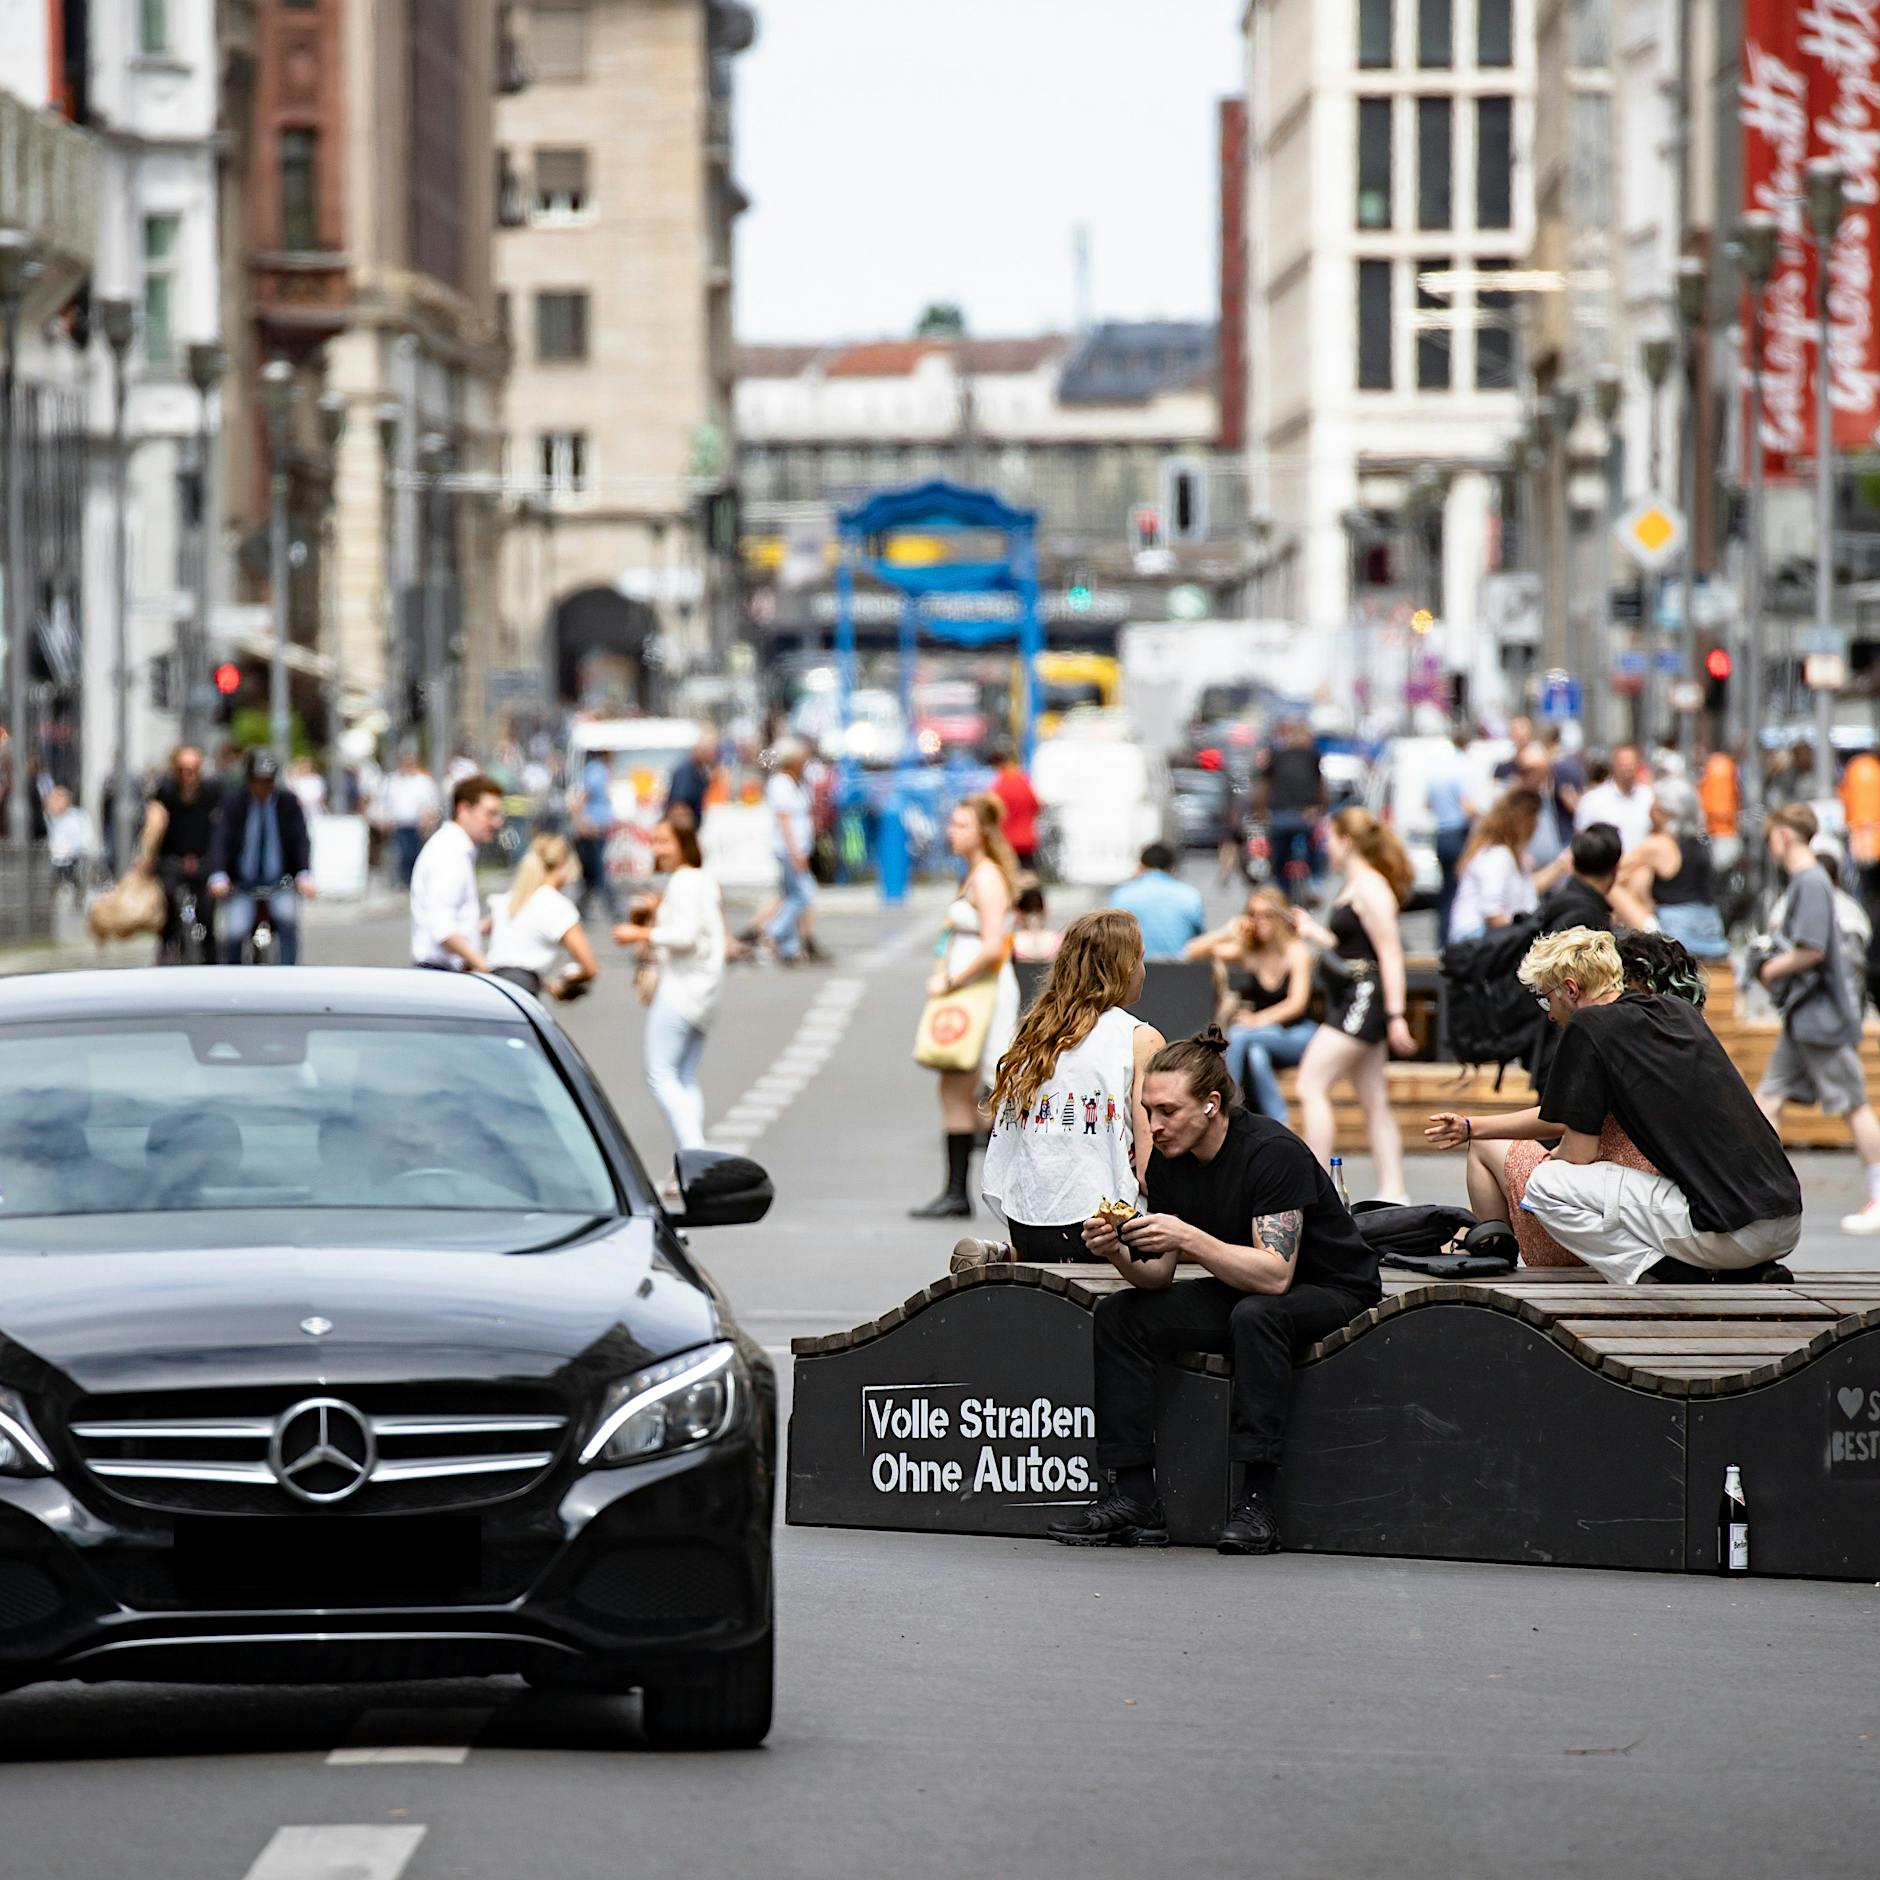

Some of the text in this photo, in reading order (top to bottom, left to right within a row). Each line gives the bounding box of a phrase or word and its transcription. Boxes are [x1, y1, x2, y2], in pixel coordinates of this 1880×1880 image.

[868, 1397, 1096, 1439] Volle Straßen
[872, 1445, 1098, 1493] Ohne Autos.
